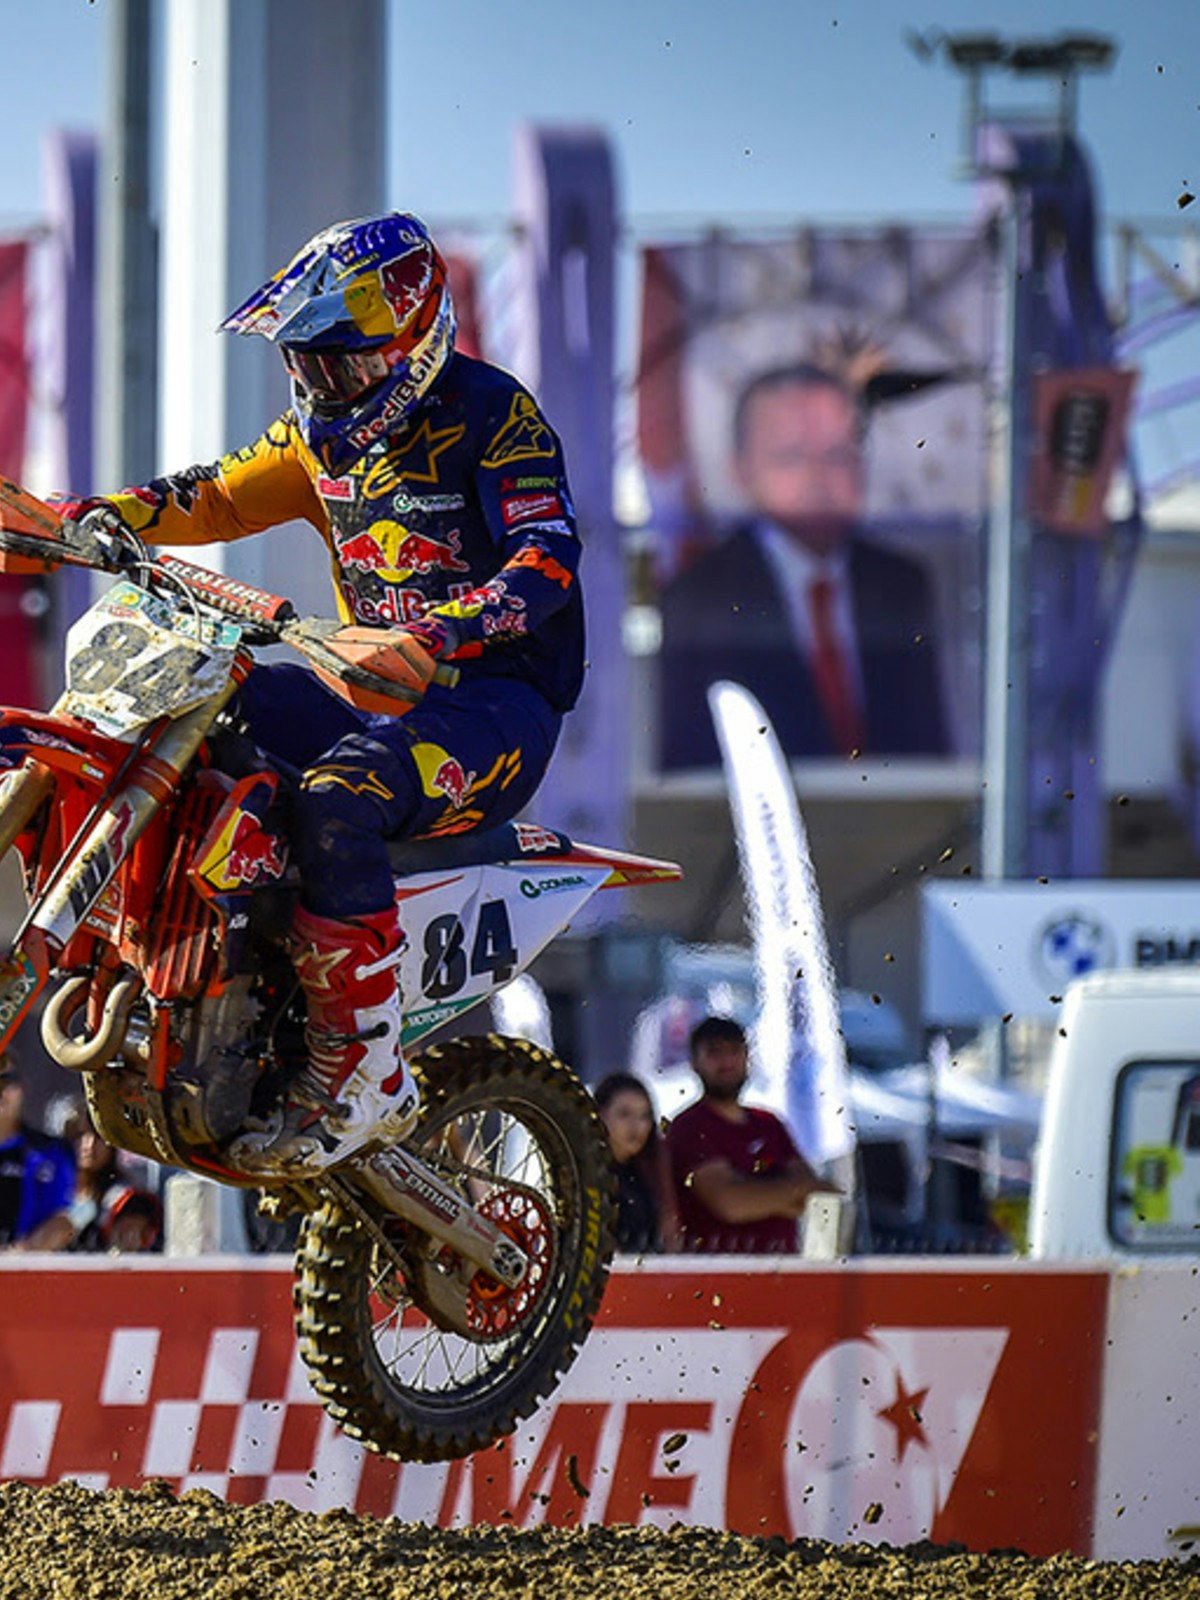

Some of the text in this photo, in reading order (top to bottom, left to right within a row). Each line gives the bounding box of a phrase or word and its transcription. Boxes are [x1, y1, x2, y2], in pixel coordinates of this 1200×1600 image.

[163, 558, 272, 608] RENTHAL
[69, 621, 212, 719] 84
[421, 898, 518, 1001] 84
